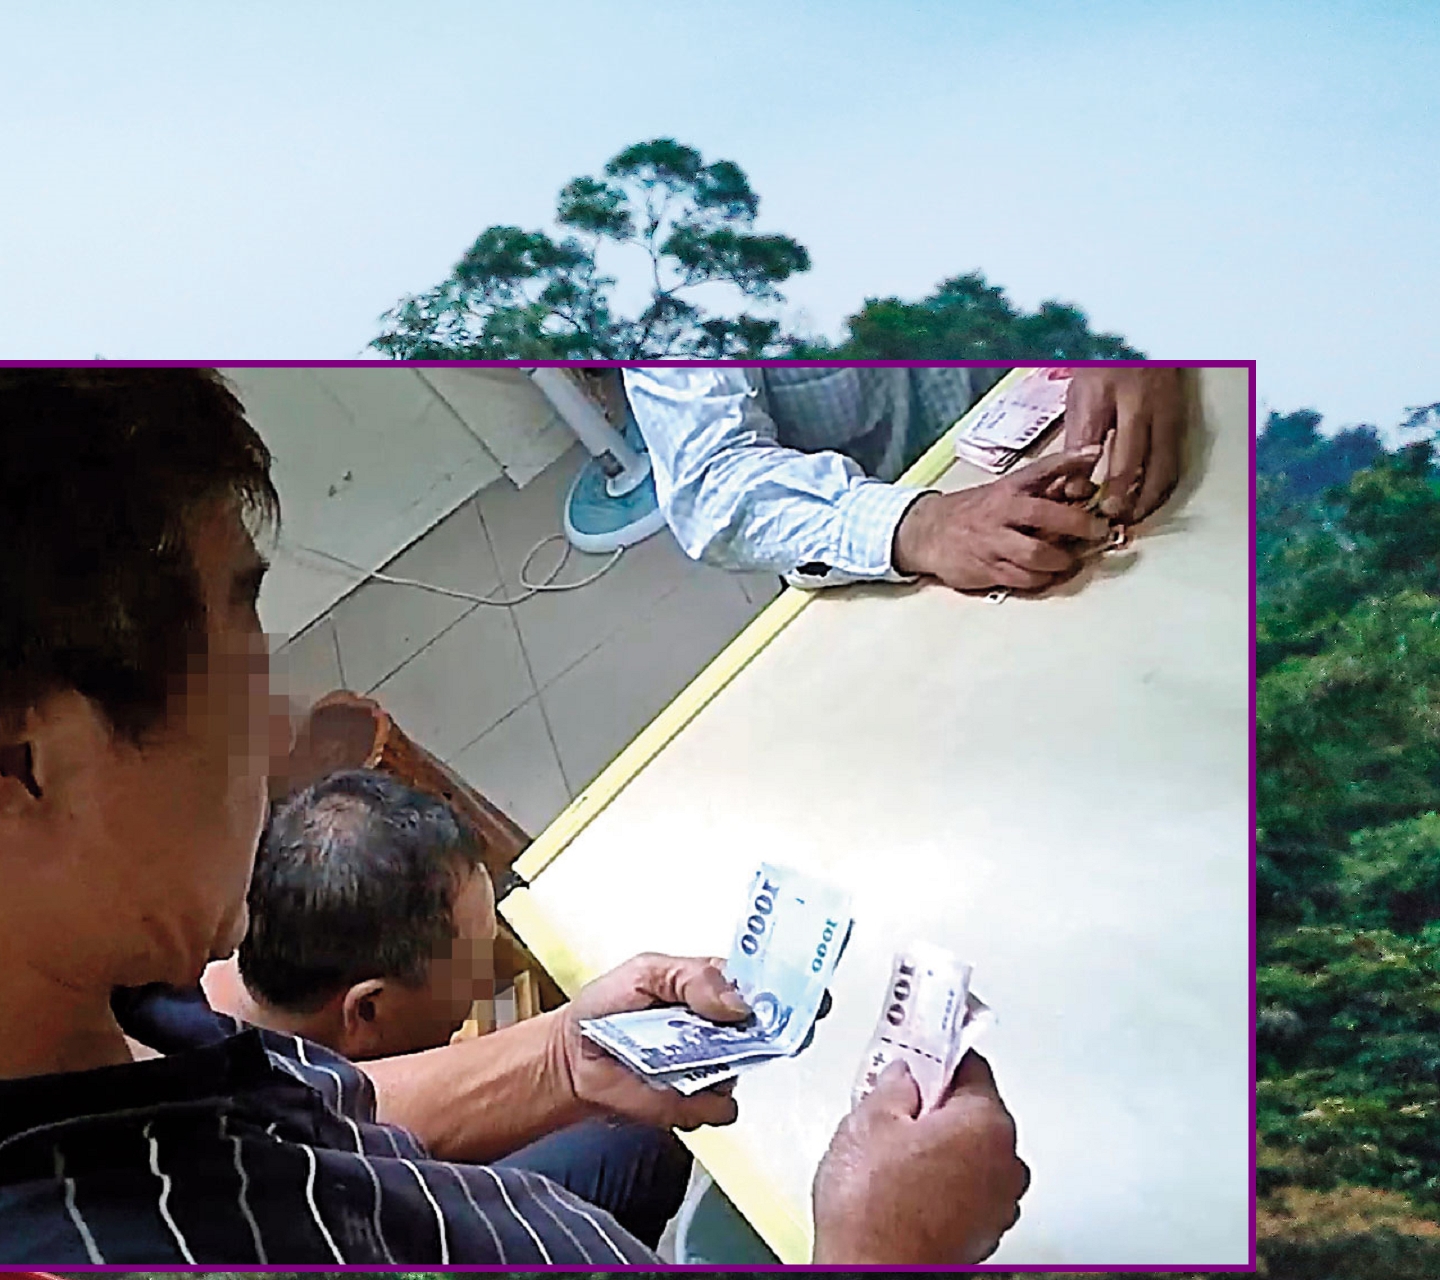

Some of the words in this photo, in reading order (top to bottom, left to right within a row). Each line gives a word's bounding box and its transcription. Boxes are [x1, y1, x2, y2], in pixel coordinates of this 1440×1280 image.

[740, 878, 781, 957] 1000
[810, 917, 840, 974] 1000
[885, 962, 917, 1028] 100
